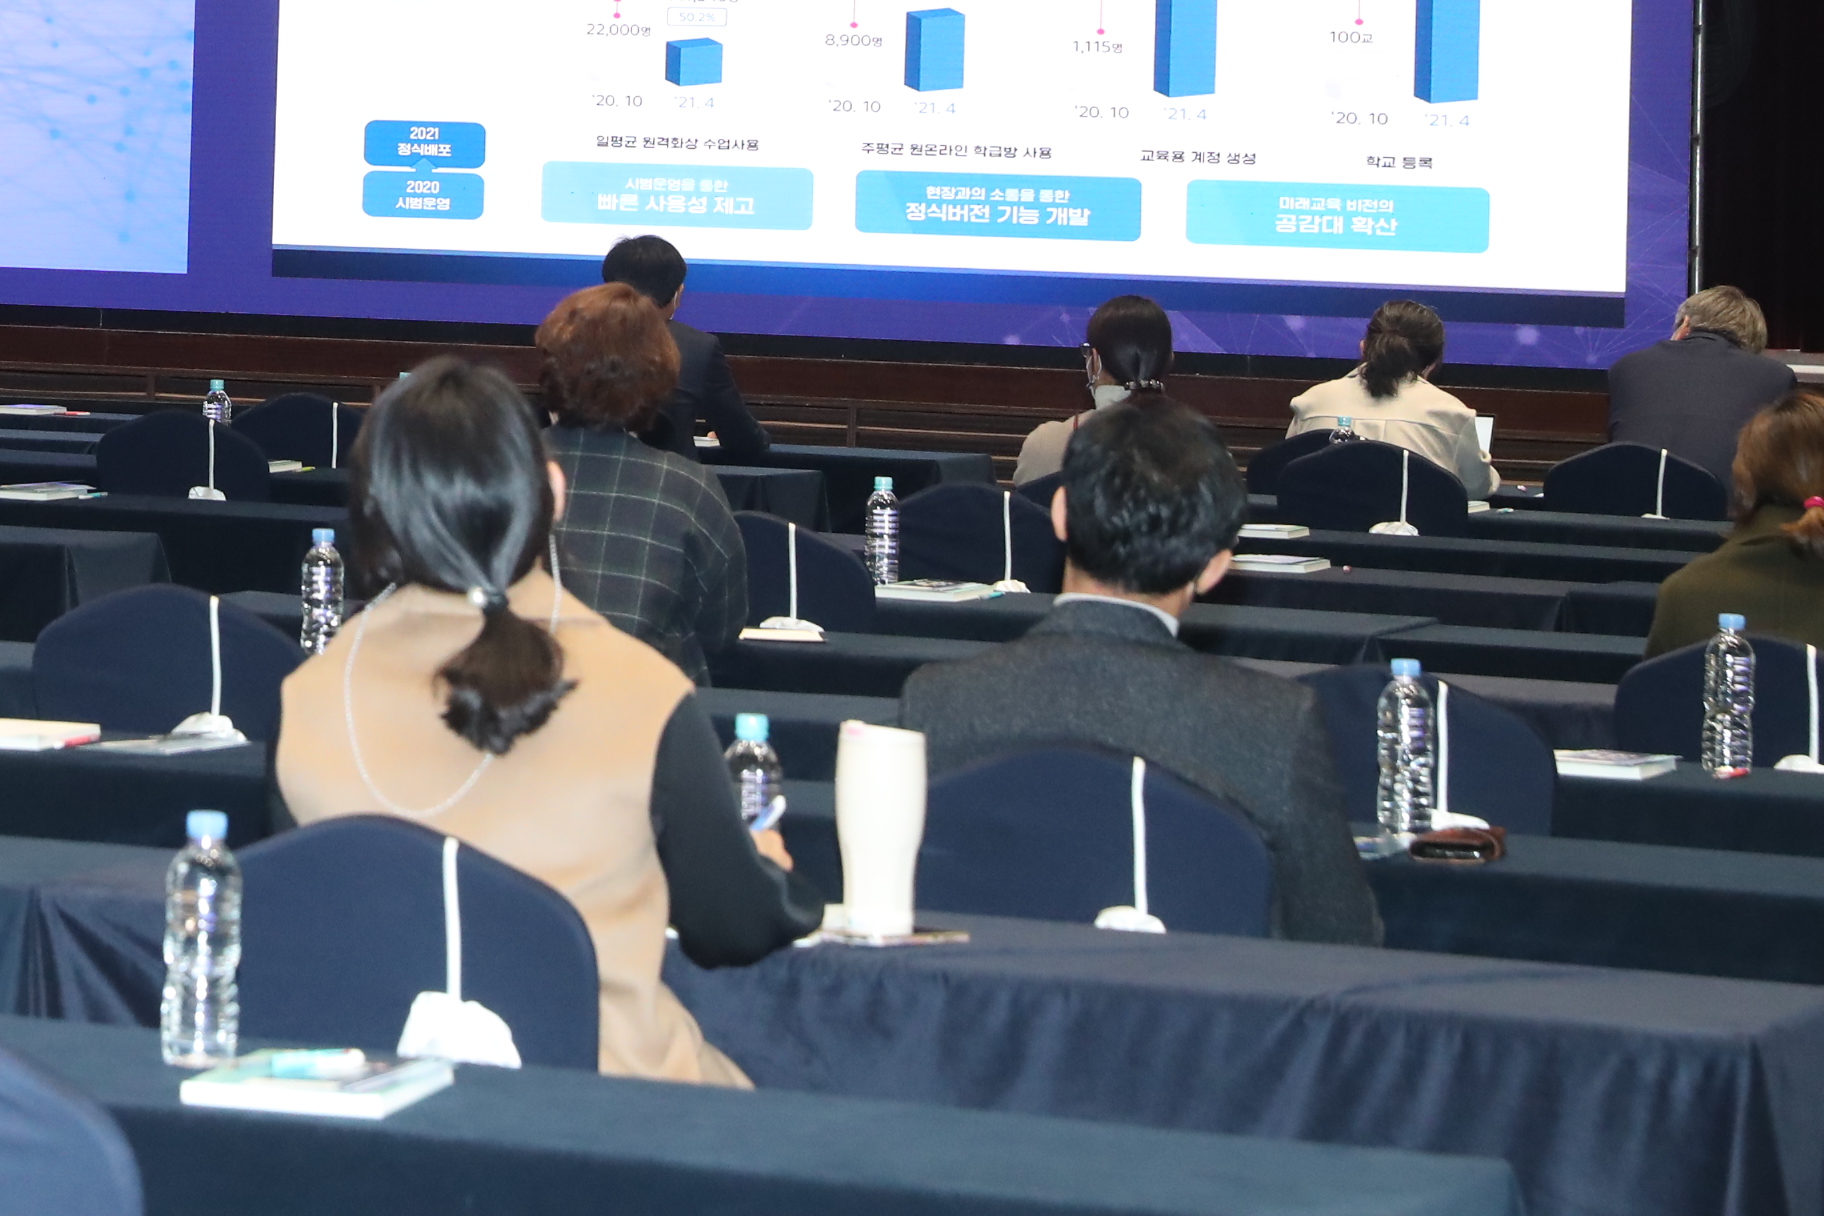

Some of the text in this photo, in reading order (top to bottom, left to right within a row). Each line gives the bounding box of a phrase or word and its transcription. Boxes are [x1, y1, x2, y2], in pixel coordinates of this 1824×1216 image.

[679, 12, 716, 23] 50.2%
[586, 23, 652, 38] 22,000명
[1330, 31, 1374, 44] 100교
[824, 34, 883, 48] 8,900명
[1072, 40, 1124, 54] 1,115명
[625, 95, 643, 107] 10
[704, 97, 715, 108] 4
[863, 100, 881, 113] 10
[945, 103, 956, 114] 4
[1110, 106, 1129, 119] 10
[1196, 109, 1207, 120] 4
[1369, 112, 1388, 125] 10
[1458, 115, 1470, 126] 4
[409, 126, 440, 140] 2021
[397, 143, 452, 157] 정식배포
[596, 135, 760, 151] 일평균 원격화상 수업사용
[861, 142, 904, 155] 주평균
[973, 145, 1018, 158] 학급방
[1022, 146, 1052, 159] 사용
[1140, 149, 1257, 165] 교육용 계정 생성
[1366, 156, 1396, 168] 학교
[406, 180, 440, 194] 2020
[926, 185, 985, 200] 현장과의
[395, 197, 451, 211] 시범운영
[597, 193, 755, 215] 빠른 사용성 제고
[1279, 196, 1394, 213] 미래교육 비전의
[905, 202, 1091, 226] 정식버전 기능 개발
[1275, 214, 1398, 236] 공감대 확산
